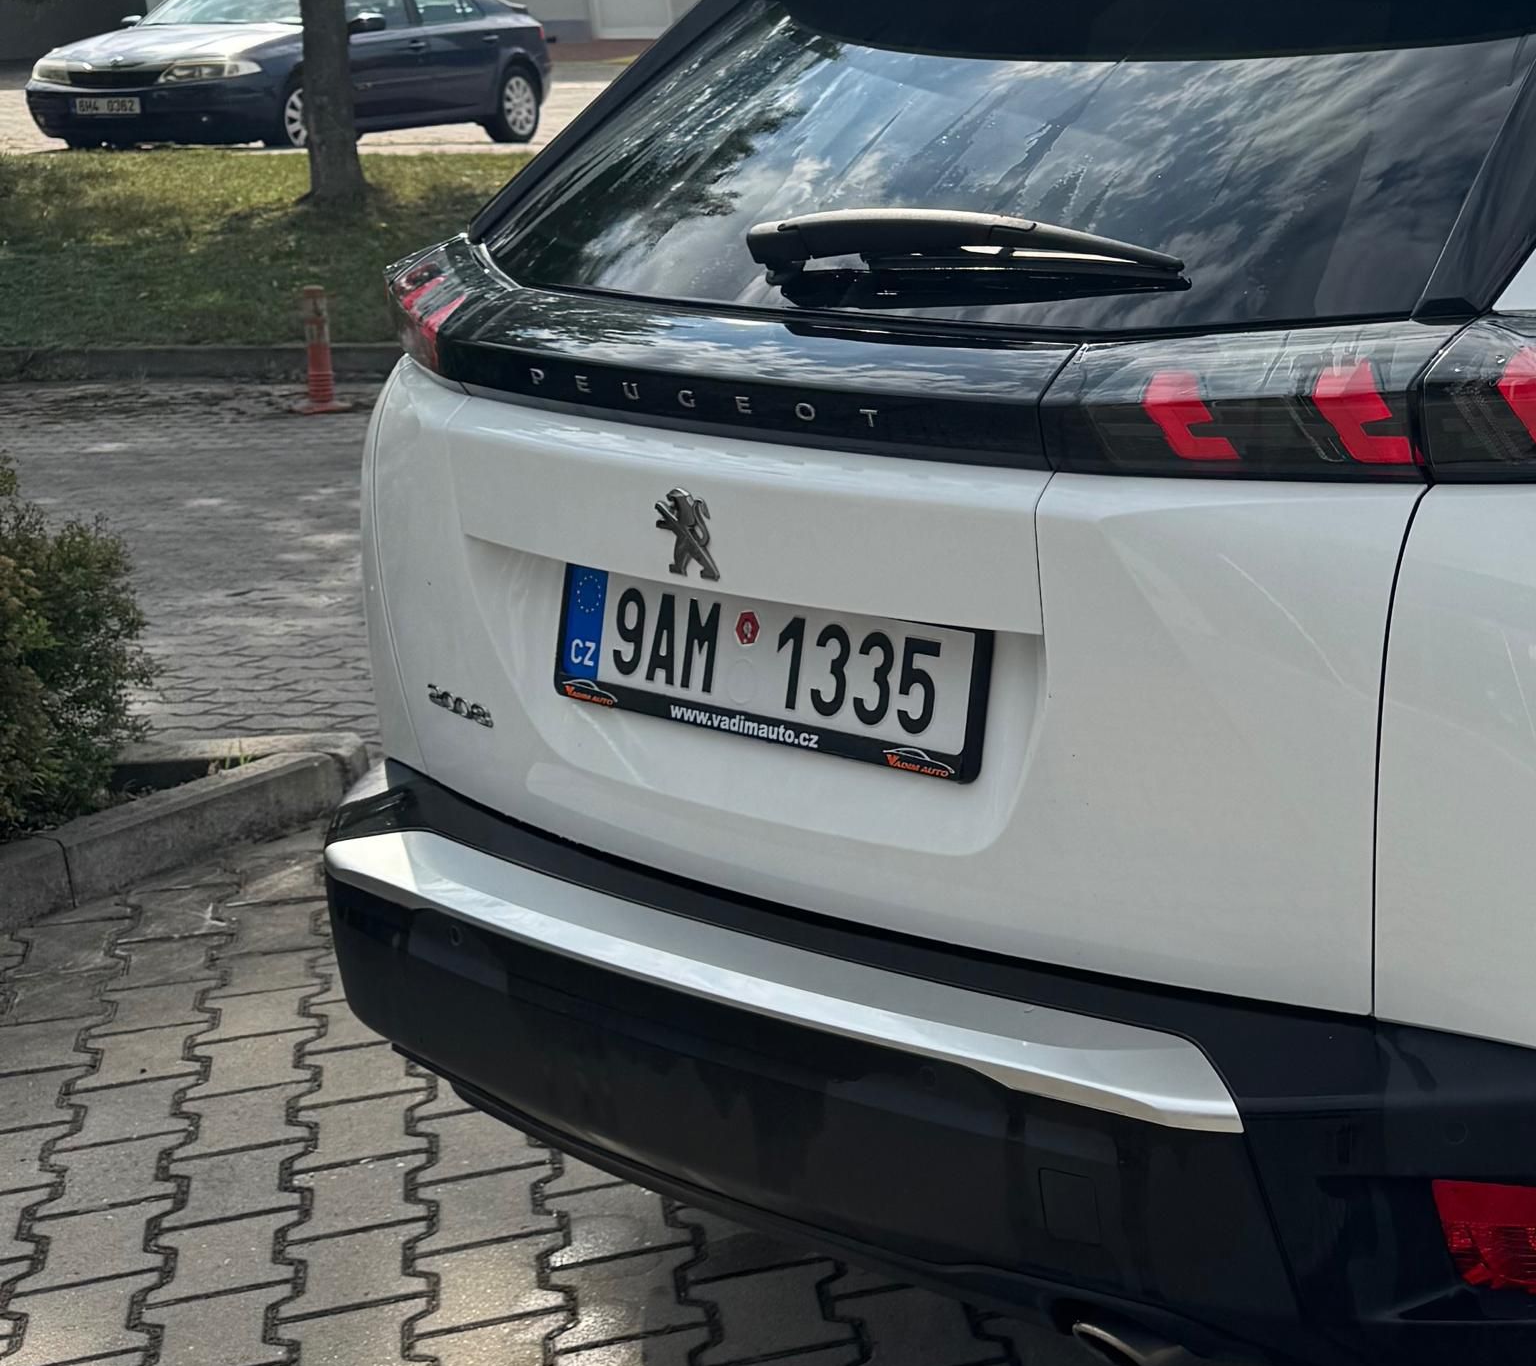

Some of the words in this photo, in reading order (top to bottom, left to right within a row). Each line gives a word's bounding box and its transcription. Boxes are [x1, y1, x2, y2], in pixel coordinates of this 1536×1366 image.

[529, 367, 879, 428] PEUGEOT
[570, 638, 596, 667] CZ
[612, 587, 722, 694] 9AM
[776, 616, 942, 735] 1335
[427, 683, 494, 728] 2008
[669, 704, 820, 749] www.vadimauto.cz
[921, 766, 950, 777] AUTO
